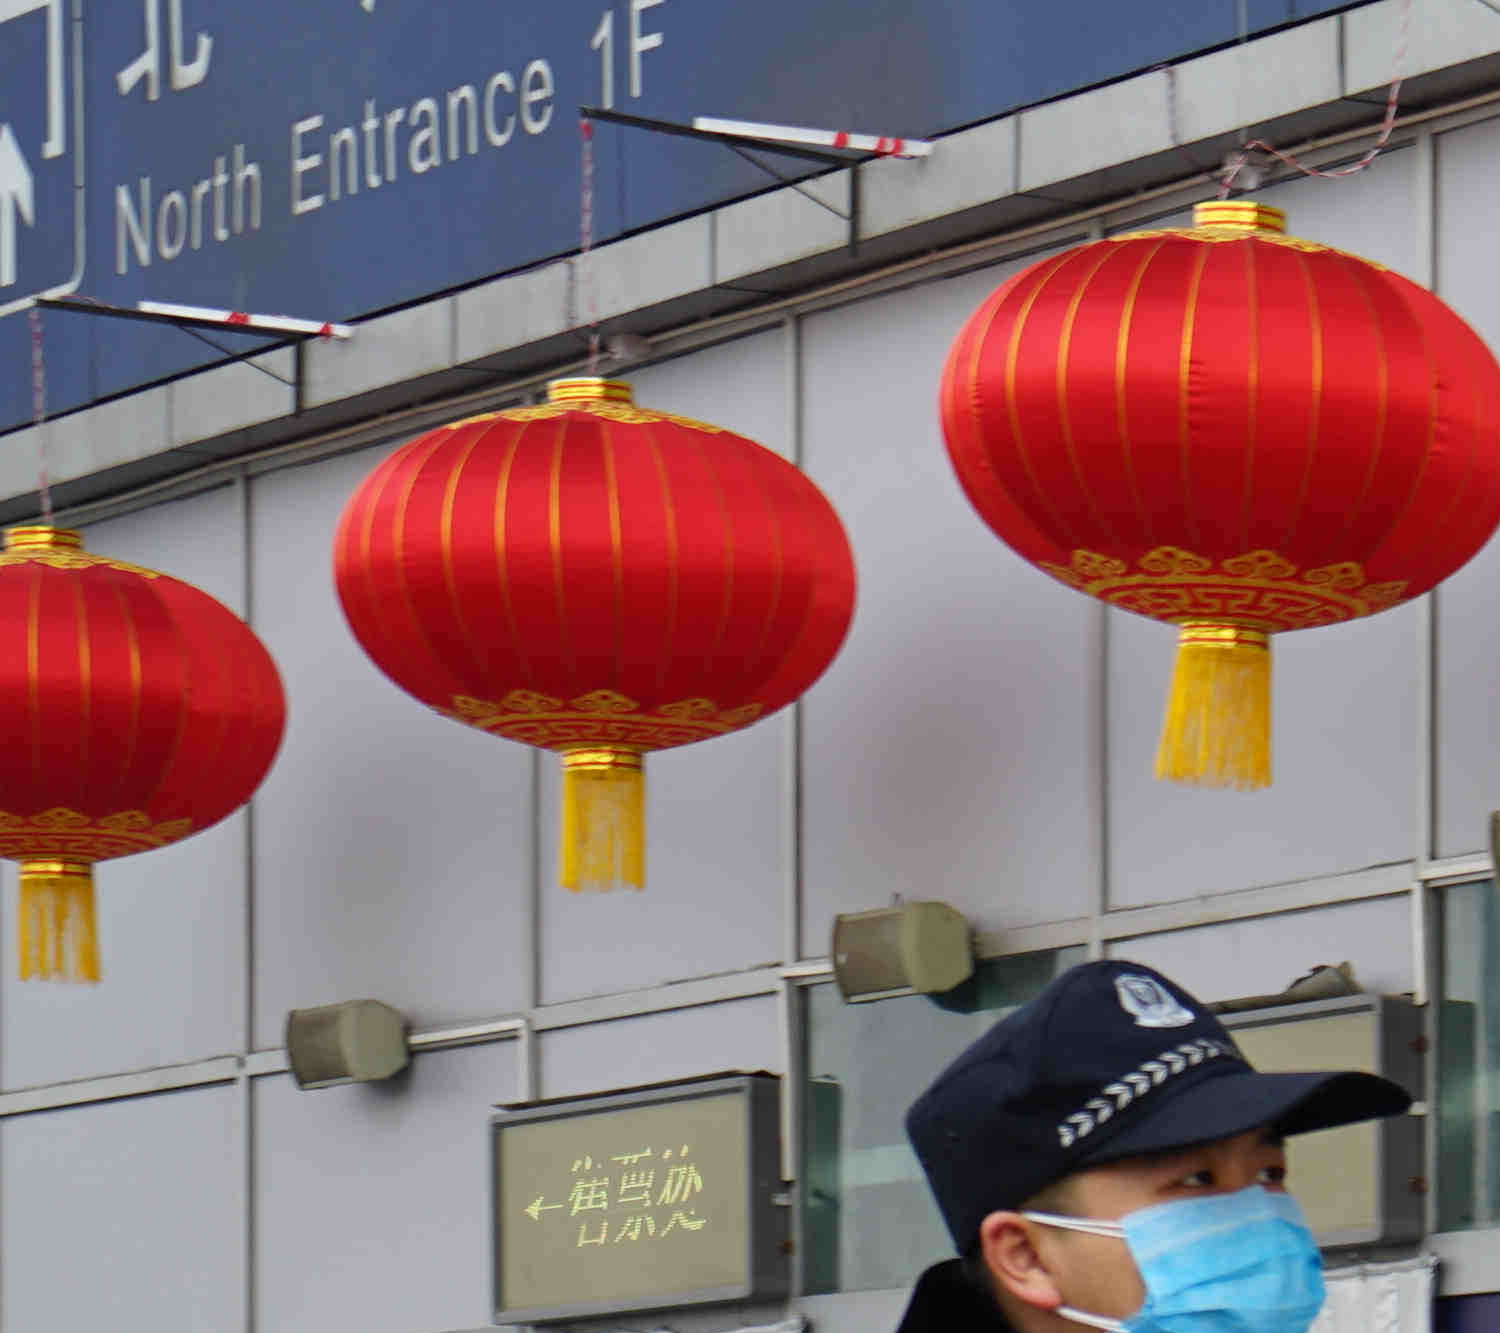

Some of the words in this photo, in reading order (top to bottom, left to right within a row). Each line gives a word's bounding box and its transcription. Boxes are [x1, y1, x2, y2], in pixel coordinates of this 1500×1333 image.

[114, 142, 263, 276] North
[290, 57, 555, 216] Entrance
[589, 0, 666, 110] 1F
